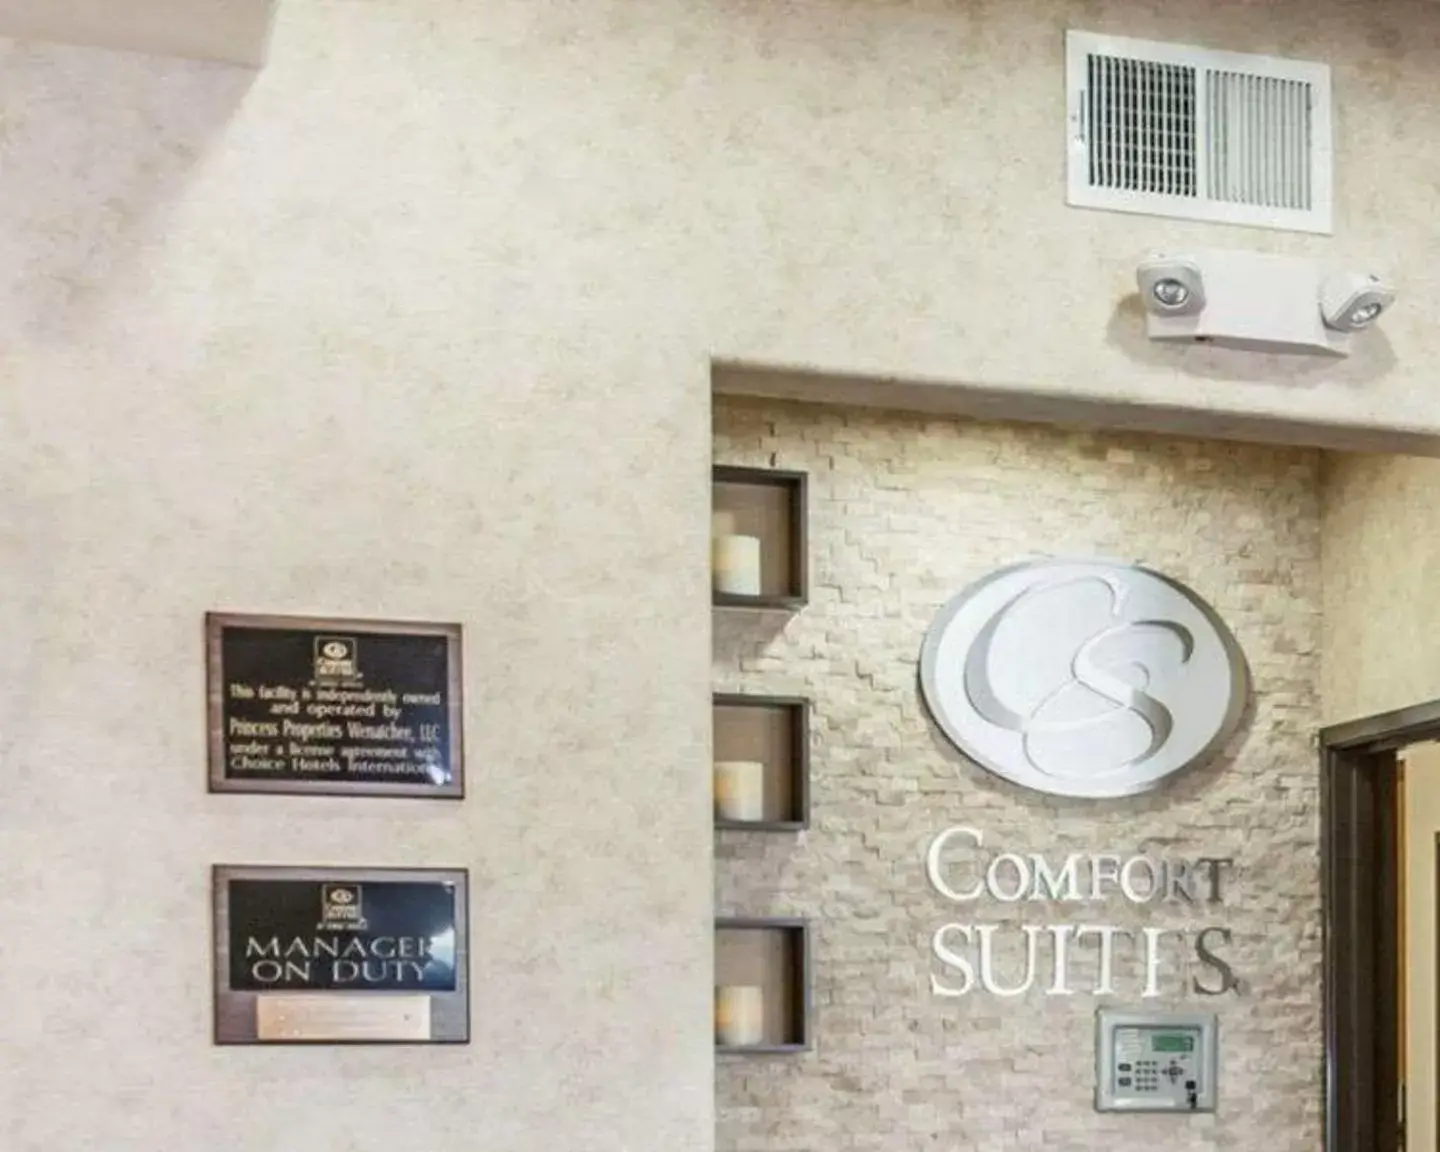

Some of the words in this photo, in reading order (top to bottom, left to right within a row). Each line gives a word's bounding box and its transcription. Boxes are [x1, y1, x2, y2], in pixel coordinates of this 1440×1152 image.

[259, 685, 298, 702] facility
[316, 688, 398, 706] independently
[402, 691, 441, 706] owned
[269, 702, 300, 716] and
[307, 704, 375, 719] operated
[383, 707, 402, 721] by
[229, 718, 278, 738] Princess
[282, 719, 344, 742] Properties
[229, 741, 270, 755] under
[340, 746, 408, 763] agreement
[230, 755, 286, 771] Choice
[291, 758, 341, 773] Hotels
[927, 825, 1234, 902] COMFORT
[251, 960, 312, 982] ON
[332, 960, 428, 982] DUTY
